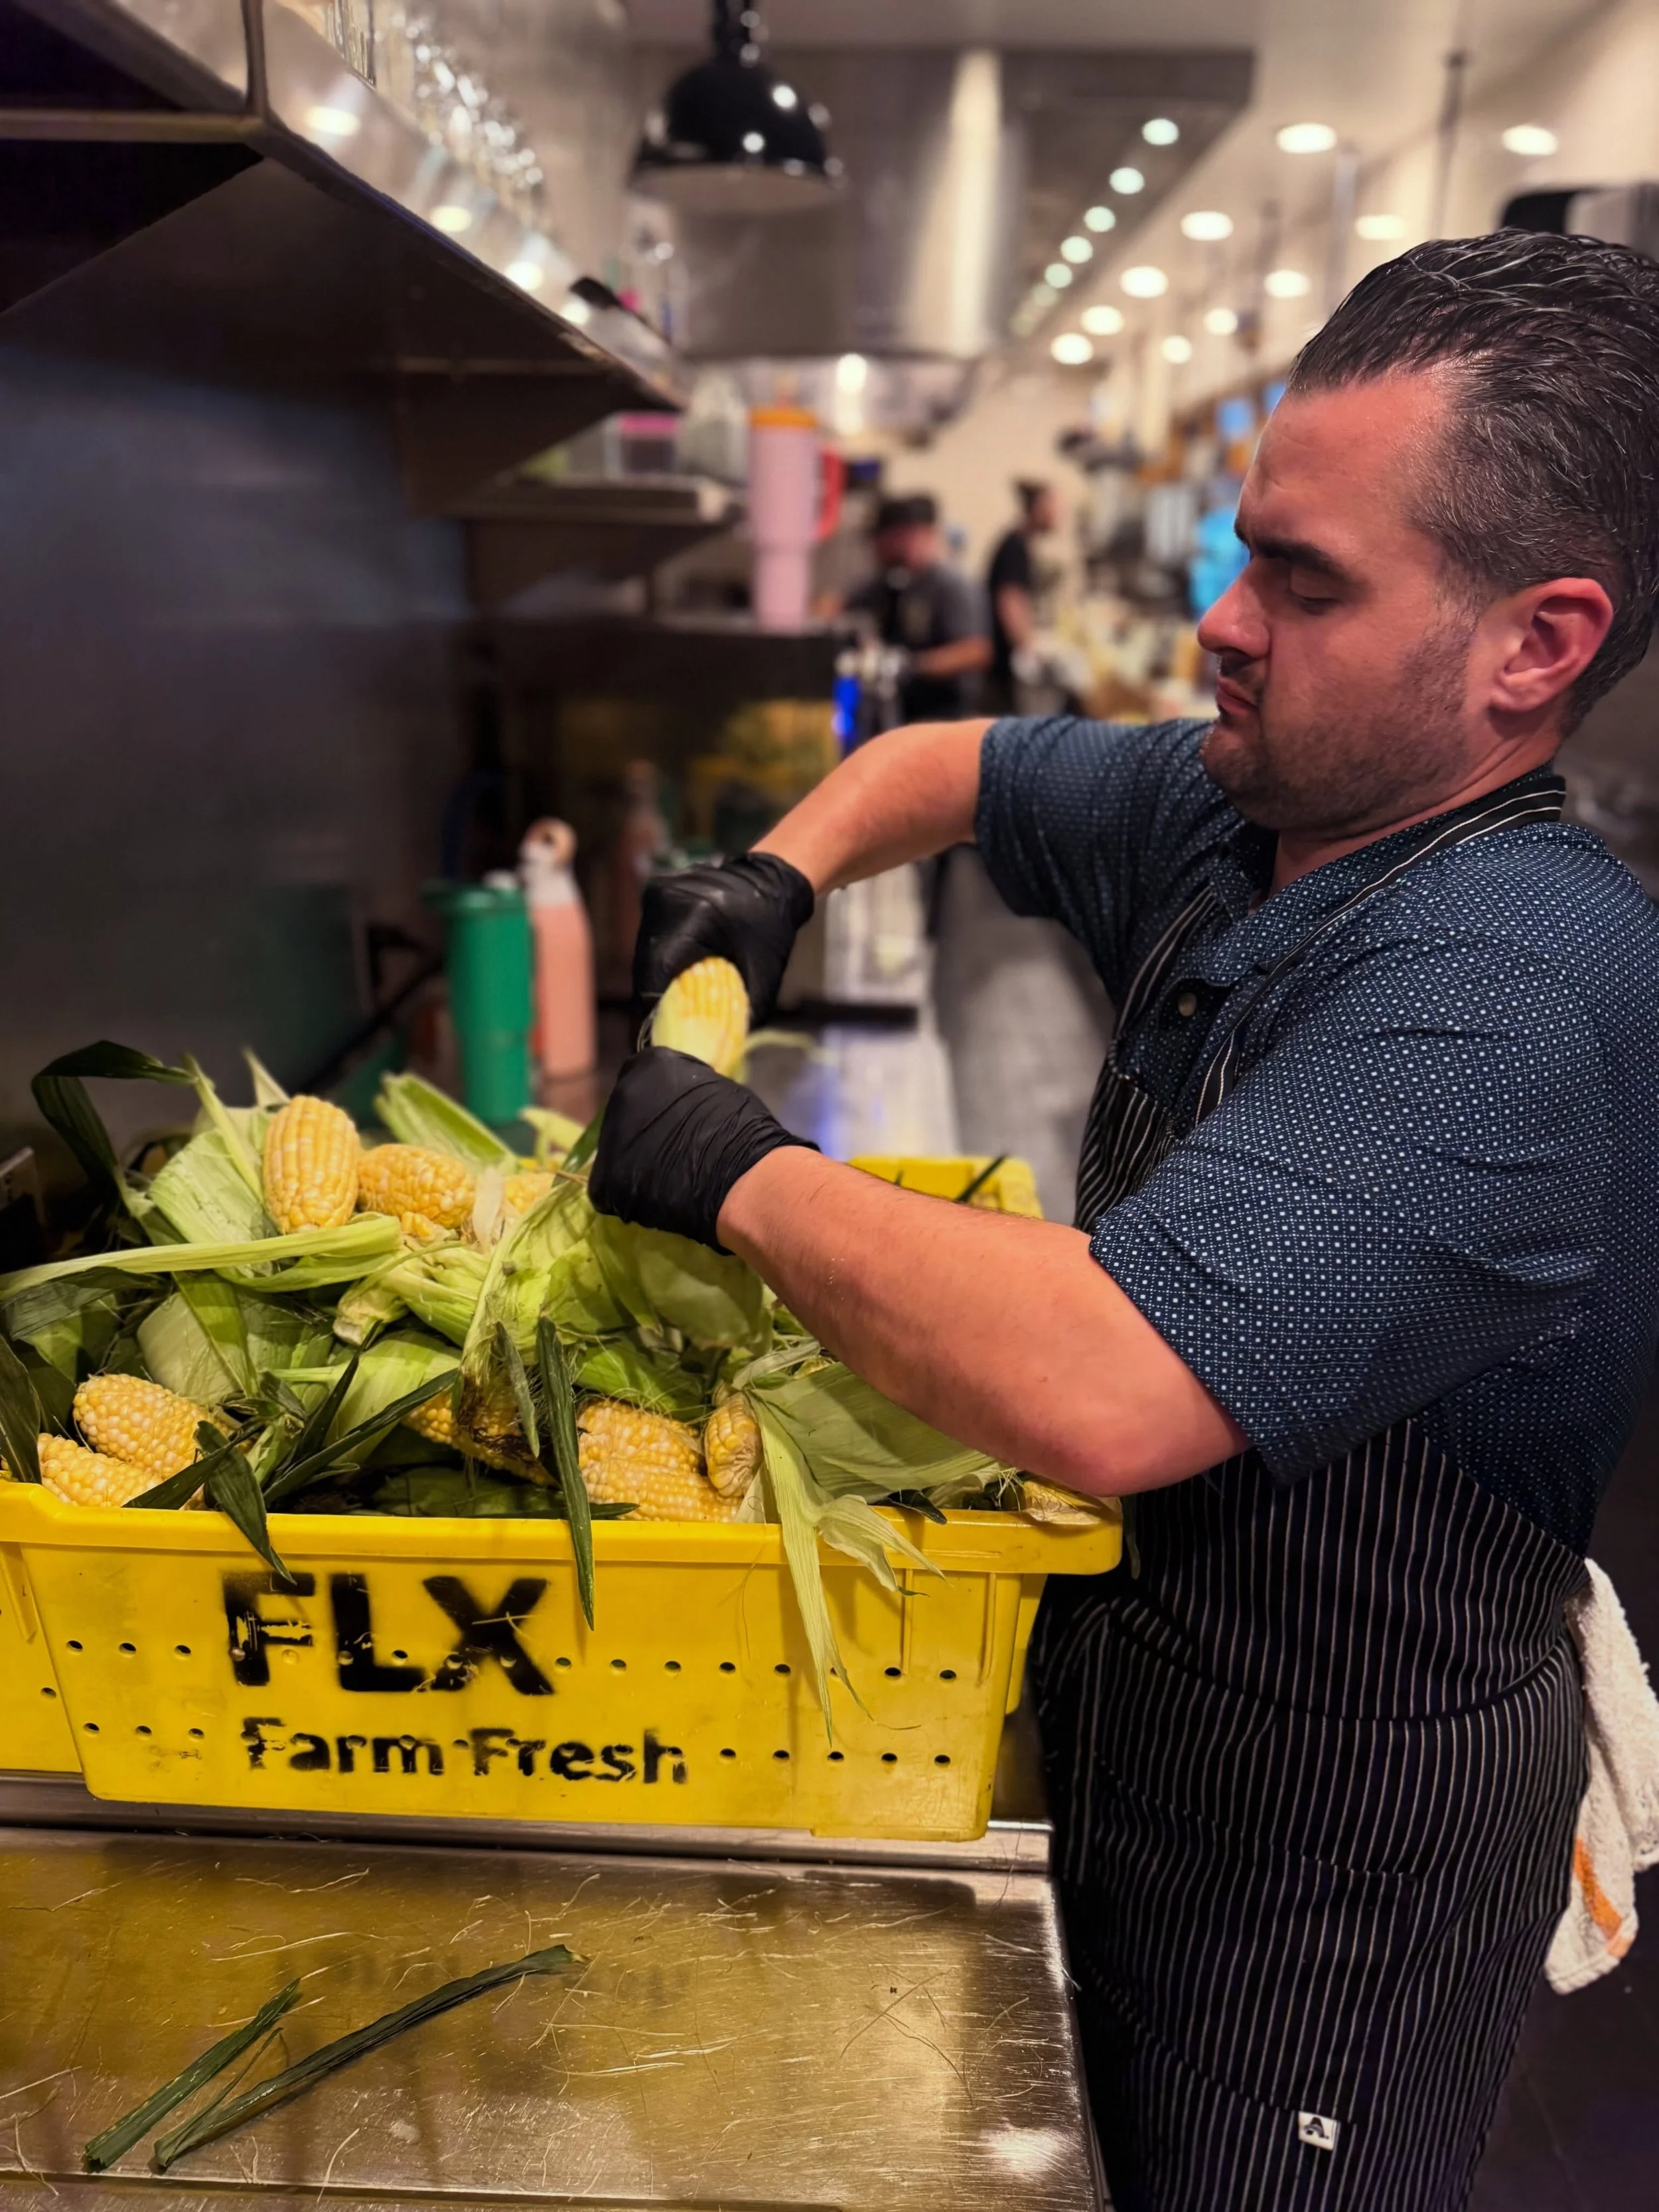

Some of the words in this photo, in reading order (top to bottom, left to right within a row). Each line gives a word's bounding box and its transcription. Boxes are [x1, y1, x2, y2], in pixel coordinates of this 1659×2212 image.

[222, 1572, 555, 1695] FLX
[243, 1716, 445, 1775] Farm
[468, 1728, 688, 1784] Fresh
